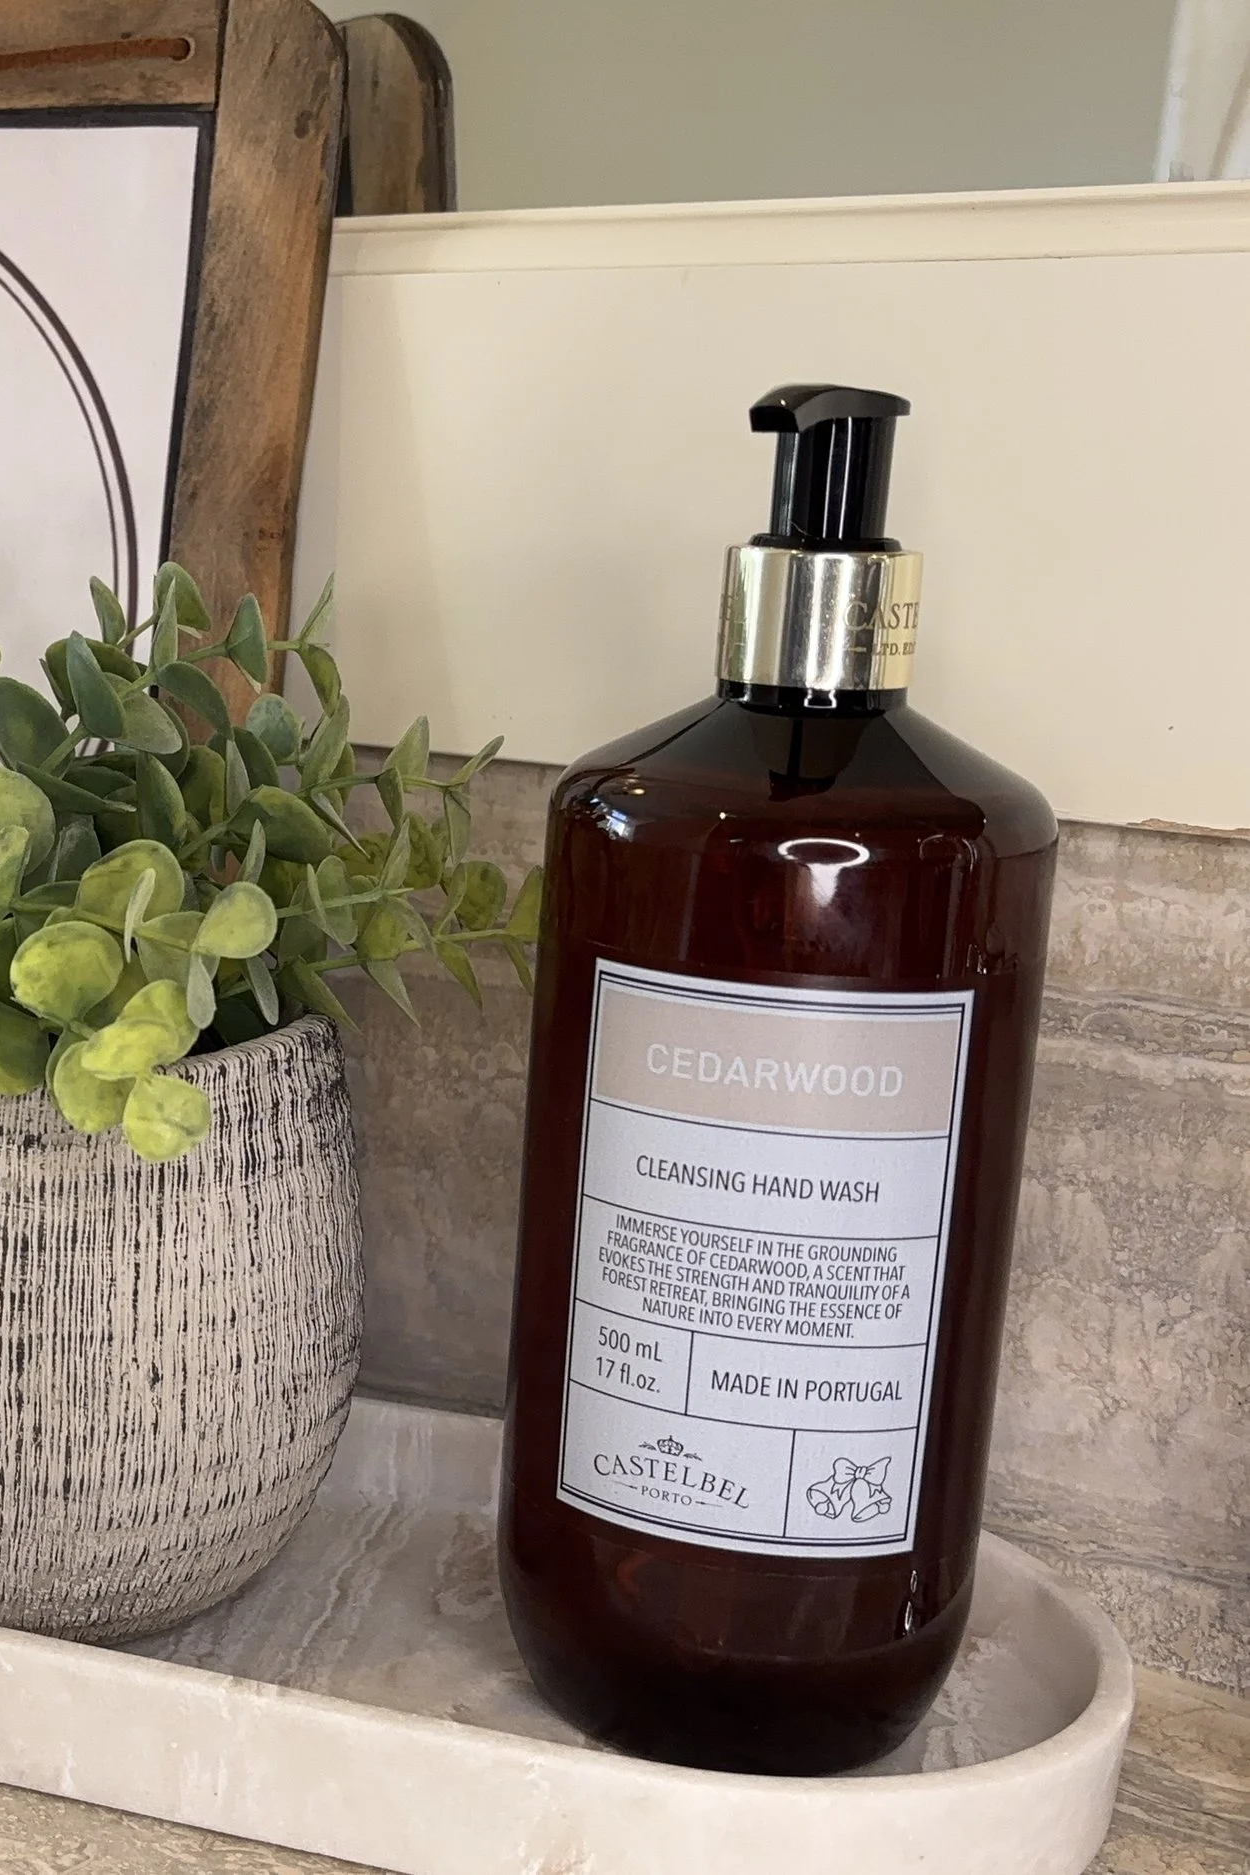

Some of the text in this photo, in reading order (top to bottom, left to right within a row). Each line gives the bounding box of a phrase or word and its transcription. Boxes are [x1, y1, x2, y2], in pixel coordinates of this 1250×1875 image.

[844, 601, 920, 631] CASTE
[649, 1044, 902, 1096] CEDARWOOD
[636, 1155, 879, 1203] CLEANSING HAND WASH
[607, 1231, 906, 1281] FRAGRANCE OF CEDARWOOD, A SCENT THAT
[616, 1214, 897, 1262] IMMERSE YOURSELF IN THE GROUNDING
[599, 1247, 910, 1301] EVOKES THE STRENGTH AND TRANQUILITY OF A
[602, 1266, 903, 1320] FOREST RETREAT, BRINGING THE ESSENCE OF
[642, 1297, 854, 1338] NATURE INTO EVERY MOMENT.
[598, 1327, 662, 1362] 500 mL
[596, 1356, 660, 1393] 17 fl.oz.
[712, 1370, 902, 1402] MADE IN PORTUGAL
[594, 1454, 749, 1509] CASTELBEL
[642, 1486, 692, 1506] PORTO
